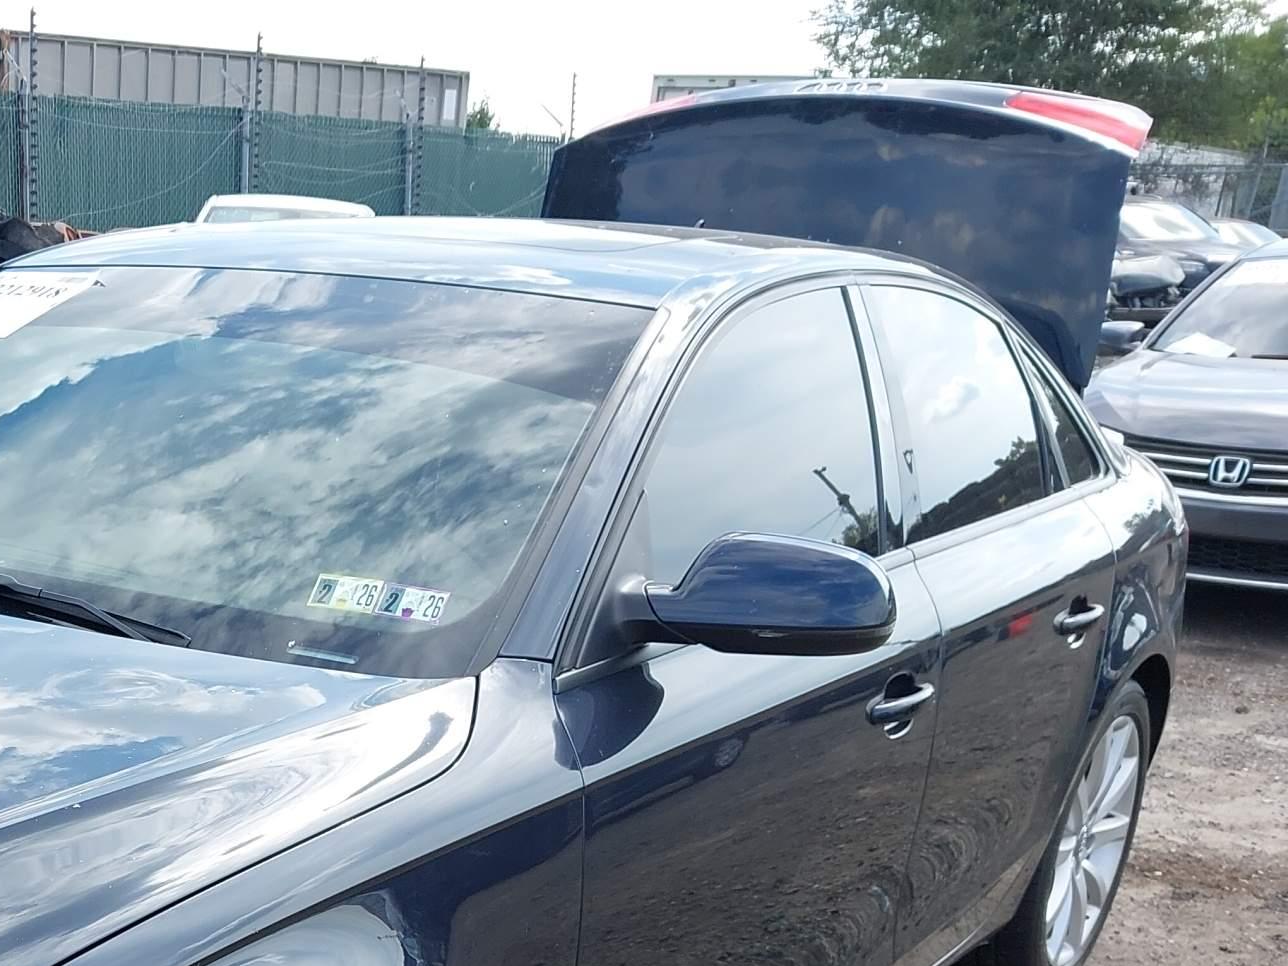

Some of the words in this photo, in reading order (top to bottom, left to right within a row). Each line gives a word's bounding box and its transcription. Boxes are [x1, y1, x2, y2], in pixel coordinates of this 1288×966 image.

[317, 583, 333, 605] 2
[357, 583, 378, 607] 26
[383, 591, 400, 614] 2
[423, 595, 444, 618] 26
